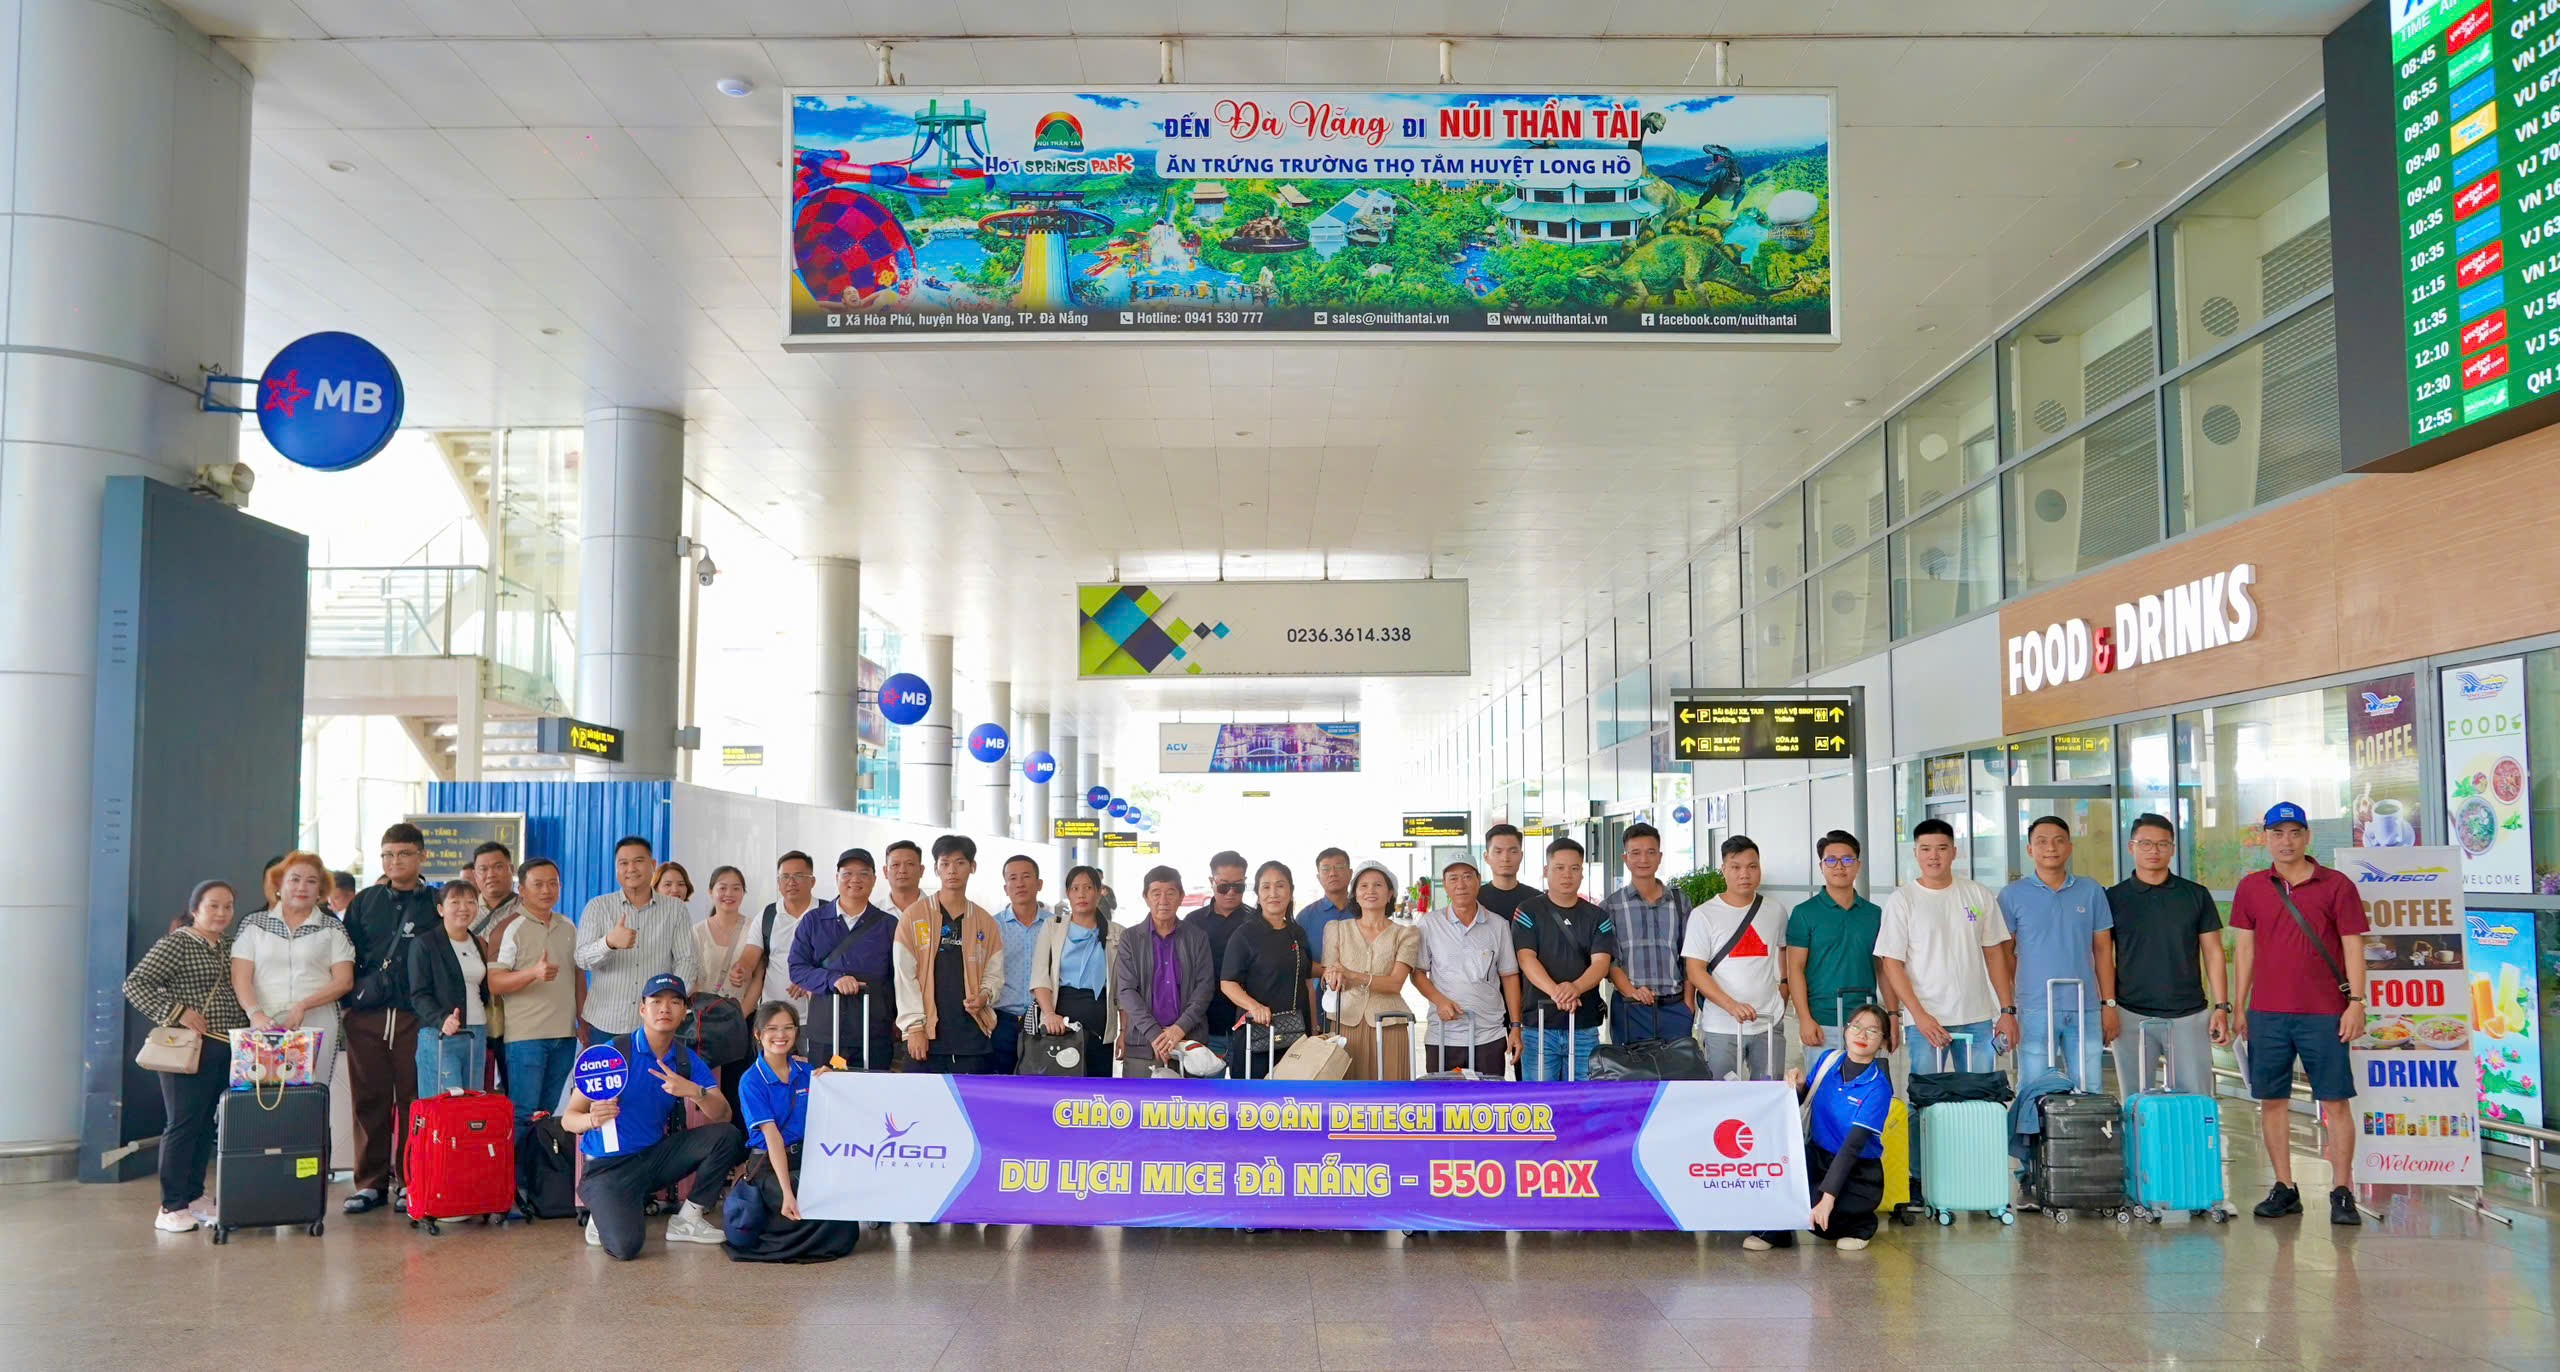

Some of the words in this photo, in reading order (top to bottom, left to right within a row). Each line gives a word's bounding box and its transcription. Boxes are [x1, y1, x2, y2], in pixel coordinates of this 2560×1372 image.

[2400, 10, 2431, 42] TIME
[2511, 10, 2536, 39] QH
[2401, 45, 2436, 79] 08:45
[2512, 47, 2536, 72] VN
[2403, 77, 2438, 110] 08:55
[2513, 82, 2537, 107] VU
[2539, 65, 2560, 92] 67
[1164, 110, 1210, 138] ĐẾN
[1214, 99, 1286, 140] Đà
[1290, 103, 1392, 147] Nẵng
[1402, 118, 1426, 138] ĐI
[1440, 102, 1492, 138] NÚI
[1503, 99, 1581, 138] THẦN
[1592, 104, 1640, 138] TÀI
[2404, 110, 2439, 142] 09:30
[2515, 117, 2539, 142] VN
[985, 154, 1019, 174] HOT
[1091, 155, 1135, 173] PARK
[1166, 154, 1196, 173] ĂN
[1202, 153, 1274, 173] TRỨNG
[1280, 153, 1368, 174] TRƯỜNG
[1374, 157, 1416, 178] THỌ
[1421, 152, 1465, 174] TẮM
[1471, 154, 1535, 179] HUYỆT
[1540, 158, 1598, 174] LONG
[1603, 153, 1632, 174] HỒ
[2405, 143, 2440, 175] 09:40
[2517, 155, 2538, 178] VJ
[2407, 176, 2442, 207] 09:40
[2518, 189, 2542, 213] VN
[2408, 209, 2443, 240] 10:35
[2520, 226, 2541, 248] VJ
[2410, 241, 2445, 272] 10:35
[2522, 261, 2545, 284] VN
[2411, 275, 2446, 304] 11:15
[846, 311, 861, 326] Xã
[864, 311, 886, 326] Hòa
[890, 311, 916, 329] Phú,
[919, 311, 953, 330] huyện
[957, 311, 979, 326] Hòa
[982, 311, 1014, 329] Vang,
[1018, 311, 1036, 326] TP.
[1039, 311, 1058, 326] Đà
[1062, 310, 1088, 328] Nẵng
[1137, 311, 1181, 325] Hotline:
[1185, 311, 1212, 325] 0941
[1215, 311, 1236, 325] 530
[1241, 311, 1263, 325] 777
[1332, 312, 1450, 327] sales@nuithantai.vn
[1503, 312, 1608, 327] www.nuithantai.vn
[1659, 312, 1797, 328] facebook.com/nuithantai
[2523, 298, 2544, 319] VJ
[2413, 308, 2447, 337] 11:35
[2415, 341, 2449, 369] 12:10
[2525, 334, 2545, 355] VJ
[2416, 374, 2451, 401] 12:30
[2527, 368, 2552, 393] QH
[314, 379, 383, 414] MB
[2418, 408, 2452, 434] 12:55
[1287, 627, 1411, 643] 0236.3614.338
[2008, 618, 2091, 696] FOOD
[2115, 563, 2258, 670] DRINKS
[901, 691, 927, 706] MB
[2448, 714, 2507, 737] FOOD
[985, 738, 1005, 749] MB
[1166, 743, 1188, 751] ACV
[2356, 723, 2414, 770] COFFEE
[1037, 763, 1053, 772] MB
[2358, 872, 2439, 884] MASCO
[2370, 979, 2445, 1008] FOOD
[585, 1078, 602, 1093] XE
[605, 1074, 622, 1090] 09
[2367, 1060, 2460, 1088] DRINK
[1053, 1094, 1133, 1128] CHÀO
[1237, 1097, 1322, 1132] ĐOÀN
[1329, 1103, 1433, 1132] DETECH
[1442, 1103, 1555, 1132] MOTOR
[820, 1141, 947, 1171] VINAGO
[2366, 1152, 2455, 1173] Welcome
[1000, 1158, 1050, 1193] DU
[1057, 1160, 1133, 1200] LỊCH
[1141, 1161, 1226, 1196] MICE
[1235, 1156, 1285, 1196] ĐÀ
[1294, 1153, 1391, 1198] NẴNG
[1400, 1174, 1418, 1187] -
[1429, 1159, 1506, 1197] 550
[1515, 1159, 1600, 1197] PAX
[1689, 1163, 1783, 1177] espero
